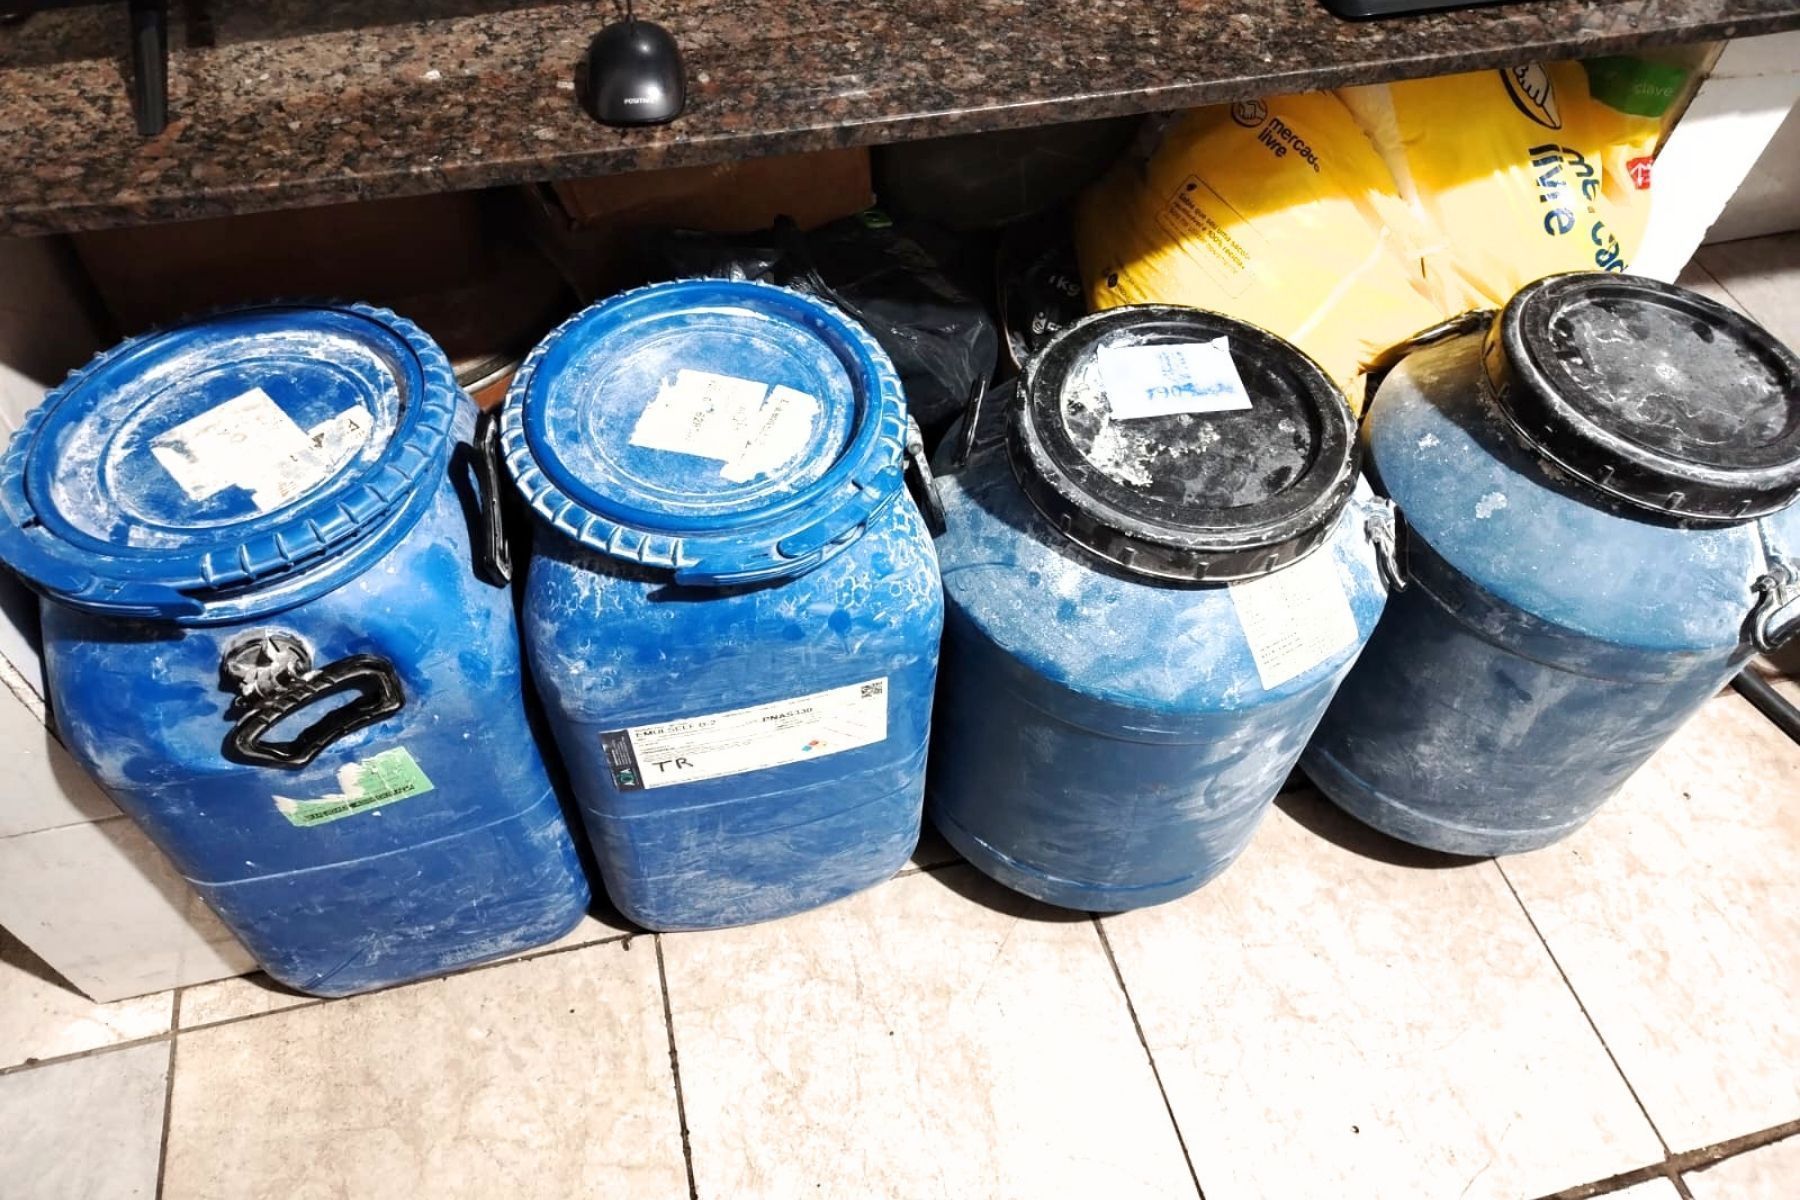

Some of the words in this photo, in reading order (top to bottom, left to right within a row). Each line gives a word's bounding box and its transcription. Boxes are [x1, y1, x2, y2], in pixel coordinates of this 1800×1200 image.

[1258, 127, 1288, 158] livre
[1268, 117, 1320, 173] mercado
[1528, 144, 1575, 236] livre
